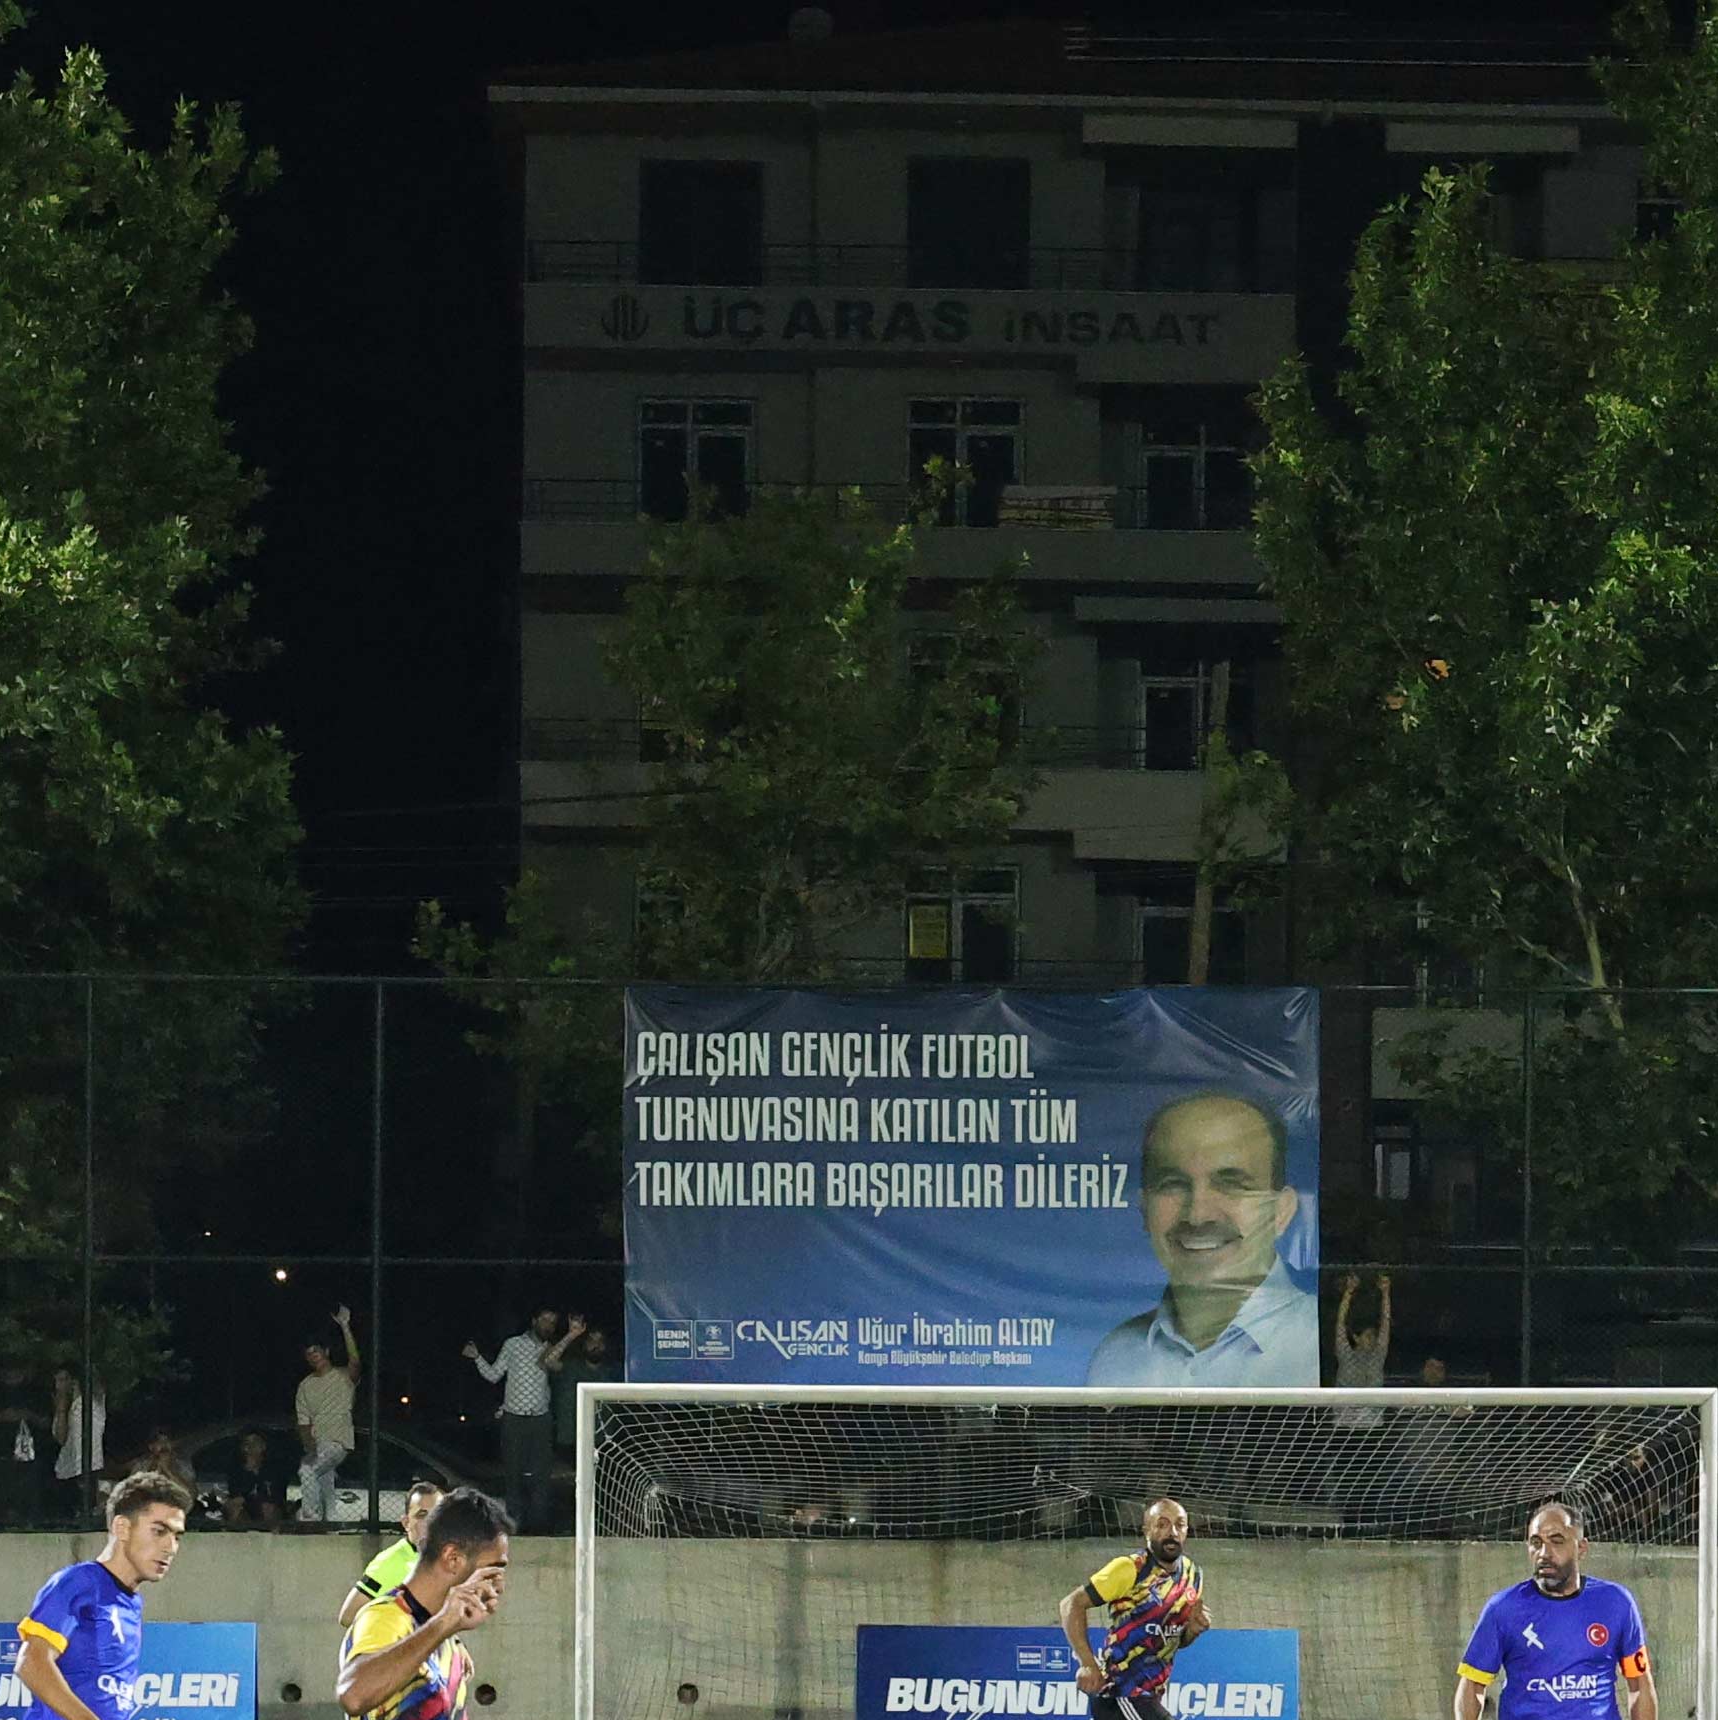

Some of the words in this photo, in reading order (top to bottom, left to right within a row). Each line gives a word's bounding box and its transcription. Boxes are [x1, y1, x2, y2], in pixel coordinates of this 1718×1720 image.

[782, 298, 970, 342] ARAS
[636, 1031, 770, 1086] ÇALIŞAN
[781, 1023, 911, 1087] GENÇLİK
[921, 1033, 1034, 1080] FUTBOL
[635, 1096, 859, 1143] TURNUVASINA
[870, 1098, 999, 1144] KATILAN
[1010, 1089, 1077, 1145] TÜM
[635, 1161, 815, 1207] TAKIMLARA
[826, 1162, 1004, 1217] BAŞARILAR
[1014, 1153, 1128, 1209] DİLERİZ
[858, 1317, 907, 1350] Uğur
[913, 1311, 992, 1346] İbrahim
[998, 1318, 1055, 1346] ALTAY
